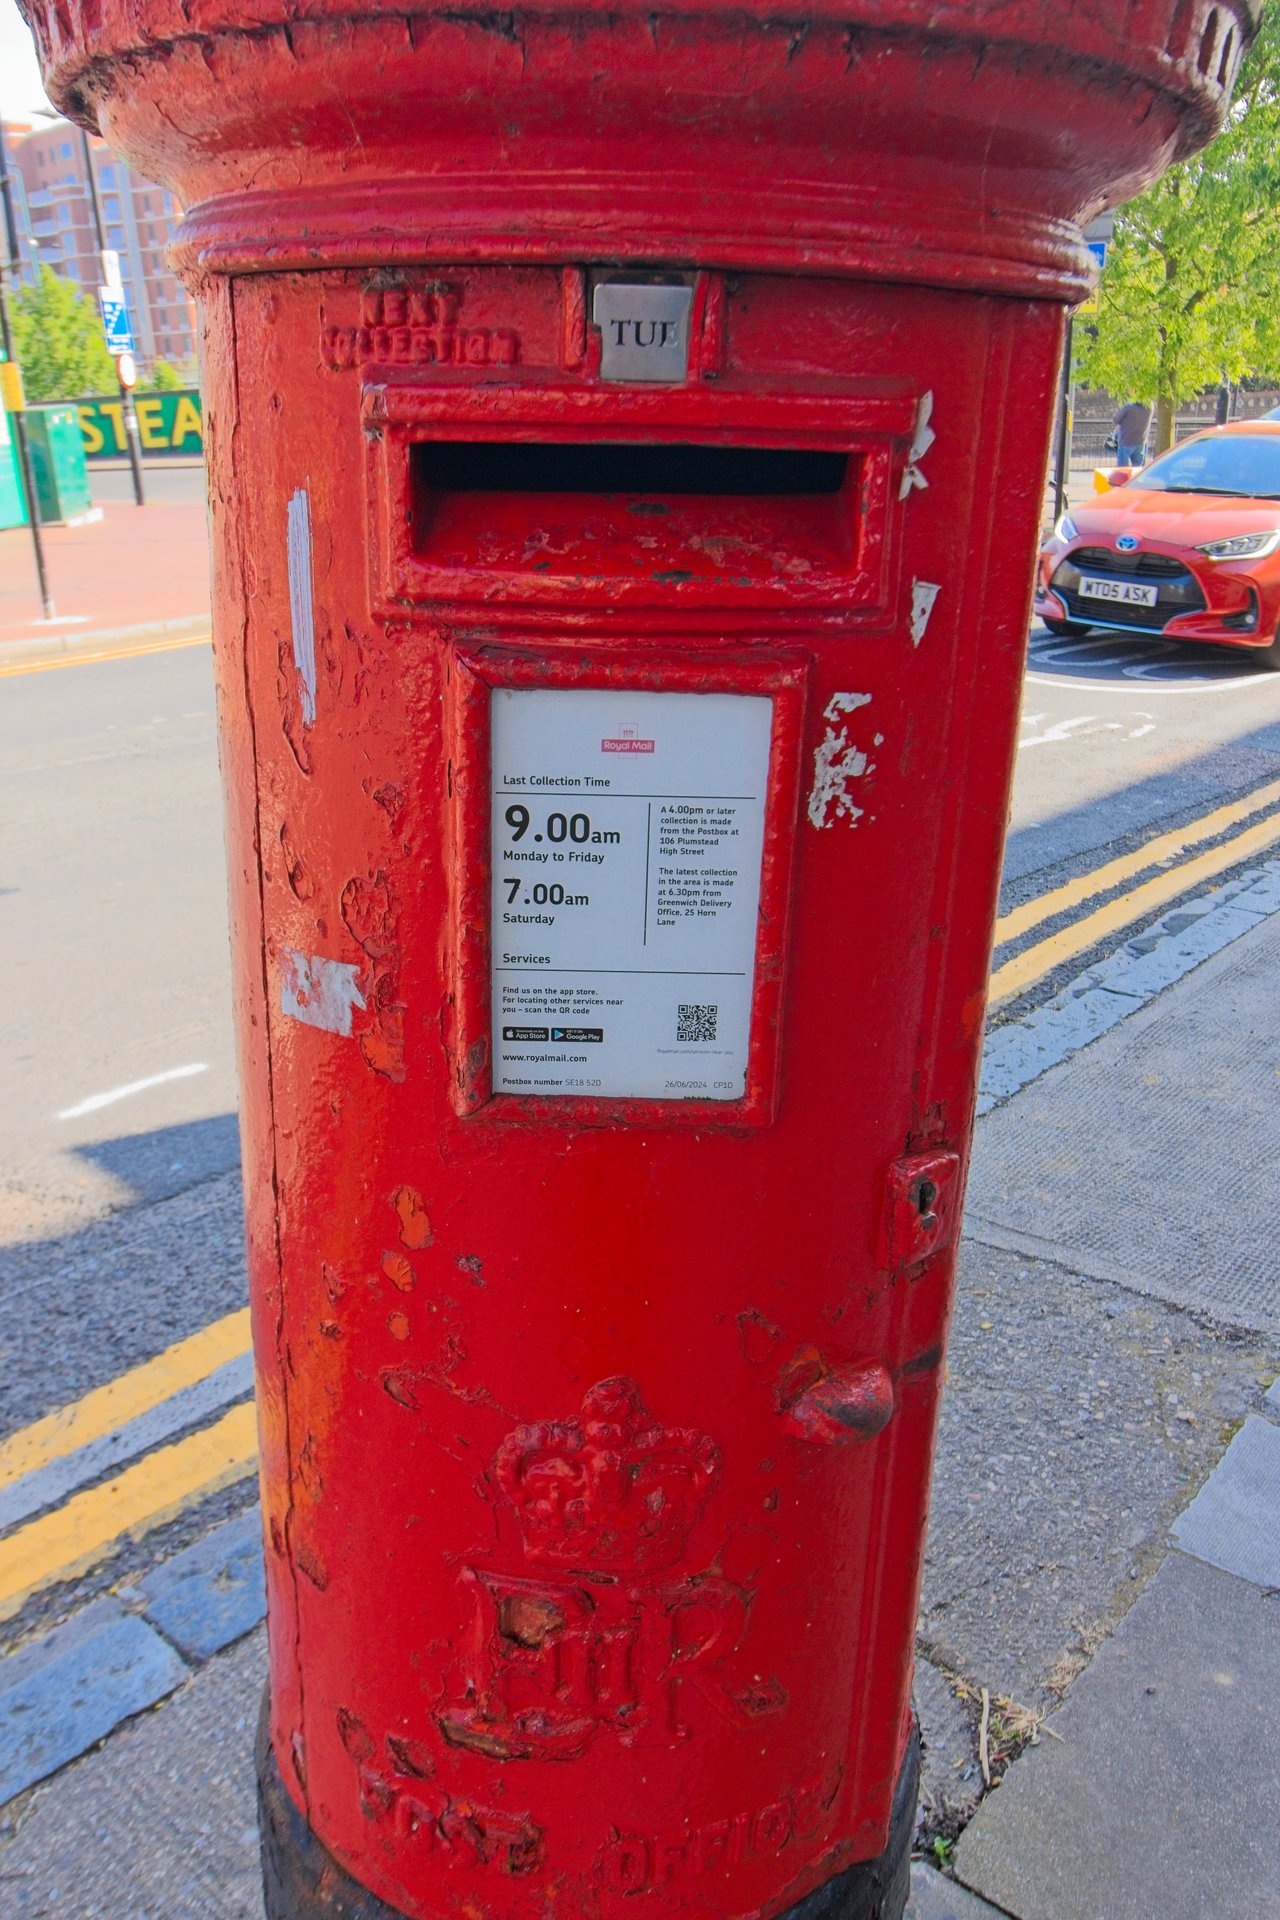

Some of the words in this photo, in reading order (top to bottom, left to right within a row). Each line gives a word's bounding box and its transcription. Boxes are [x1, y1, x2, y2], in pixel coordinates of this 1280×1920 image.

[610, 319, 679, 348] TUE
[1123, 586, 1151, 603] ASK
[604, 740, 630, 751] Royal
[631, 741, 652, 750] Mail
[503, 775, 526, 785] Last
[530, 776, 581, 786] Collection
[584, 777, 611, 787] Time
[669, 805, 703, 815] 4.00pm
[717, 807, 736, 815] later
[505, 804, 621, 844] 9.00am
[660, 817, 698, 825] collection
[660, 827, 680, 835] from
[682, 827, 695, 835] the
[660, 837, 675, 845] 106
[678, 837, 719, 846] Plumstead
[660, 848, 678, 856] High
[680, 848, 704, 856] Street
[503, 850, 549, 864] Monday
[553, 853, 564, 862] to
[569, 852, 605, 865] Friday
[659, 867, 674, 875] The
[676, 868, 698, 876] latest
[701, 868, 738, 876] collection
[503, 878, 589, 906] 7.00am
[668, 888, 700, 897] 6.30pm
[658, 898, 698, 906] Greenwich
[700, 899, 732, 908] Delivery
[657, 908, 682, 916] Office,
[503, 913, 555, 926] Saturday
[502, 953, 551, 964] Services
[502, 986, 519, 994] Find
[560, 988, 574, 996] app
[576, 988, 598, 996] store.
[502, 996, 515, 1004] For
[518, 996, 548, 1005] locating
[502, 1007, 516, 1015] you
[502, 1053, 587, 1063] www.royalmail.com
[534, 1078, 563, 1086] number
[664, 1081, 707, 1089] 26/06/2024
